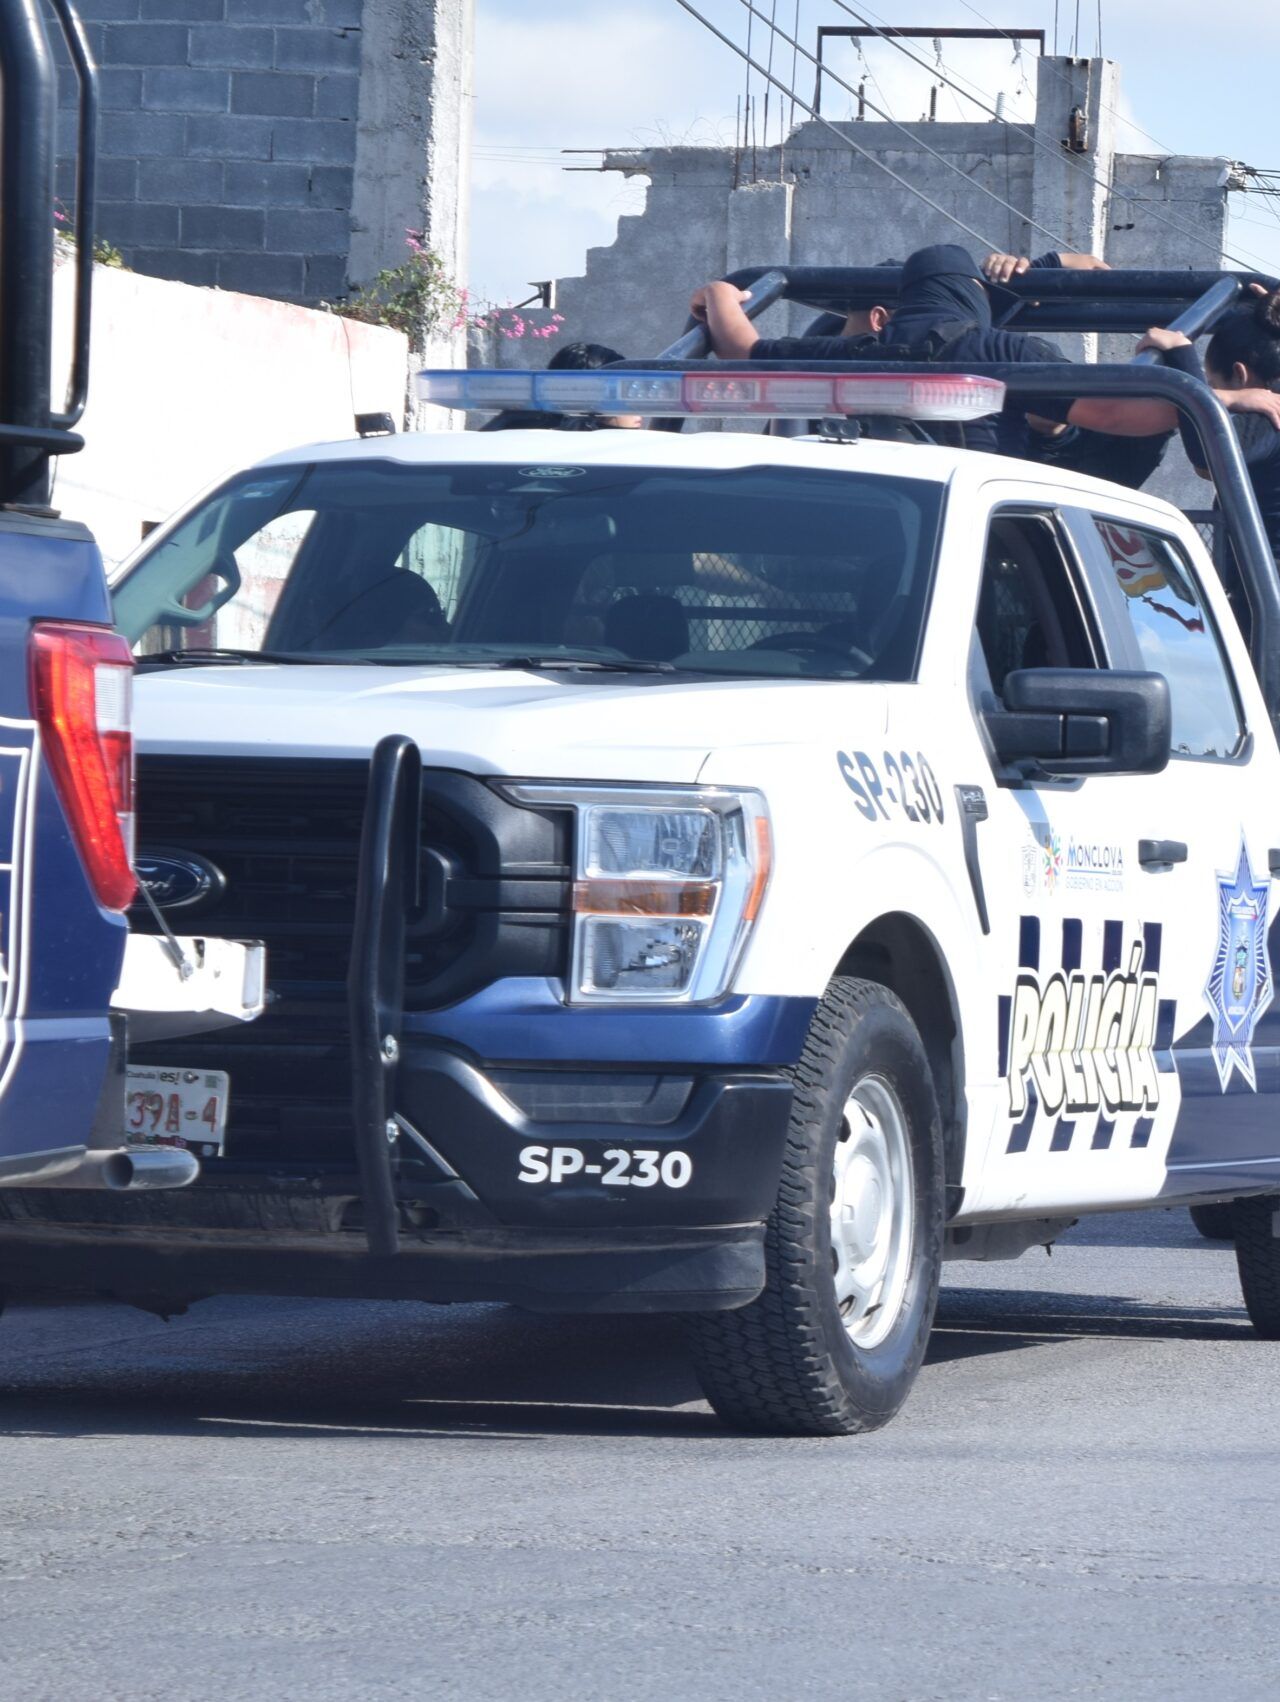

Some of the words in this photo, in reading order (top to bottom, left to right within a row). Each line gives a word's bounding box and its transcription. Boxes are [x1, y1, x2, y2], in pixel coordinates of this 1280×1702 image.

[836, 750, 945, 826] SP-230
[1066, 843, 1124, 868] MONCLOVA
[1008, 940, 1160, 1118] POLICÍA
[517, 1145, 693, 1188] SP-230
